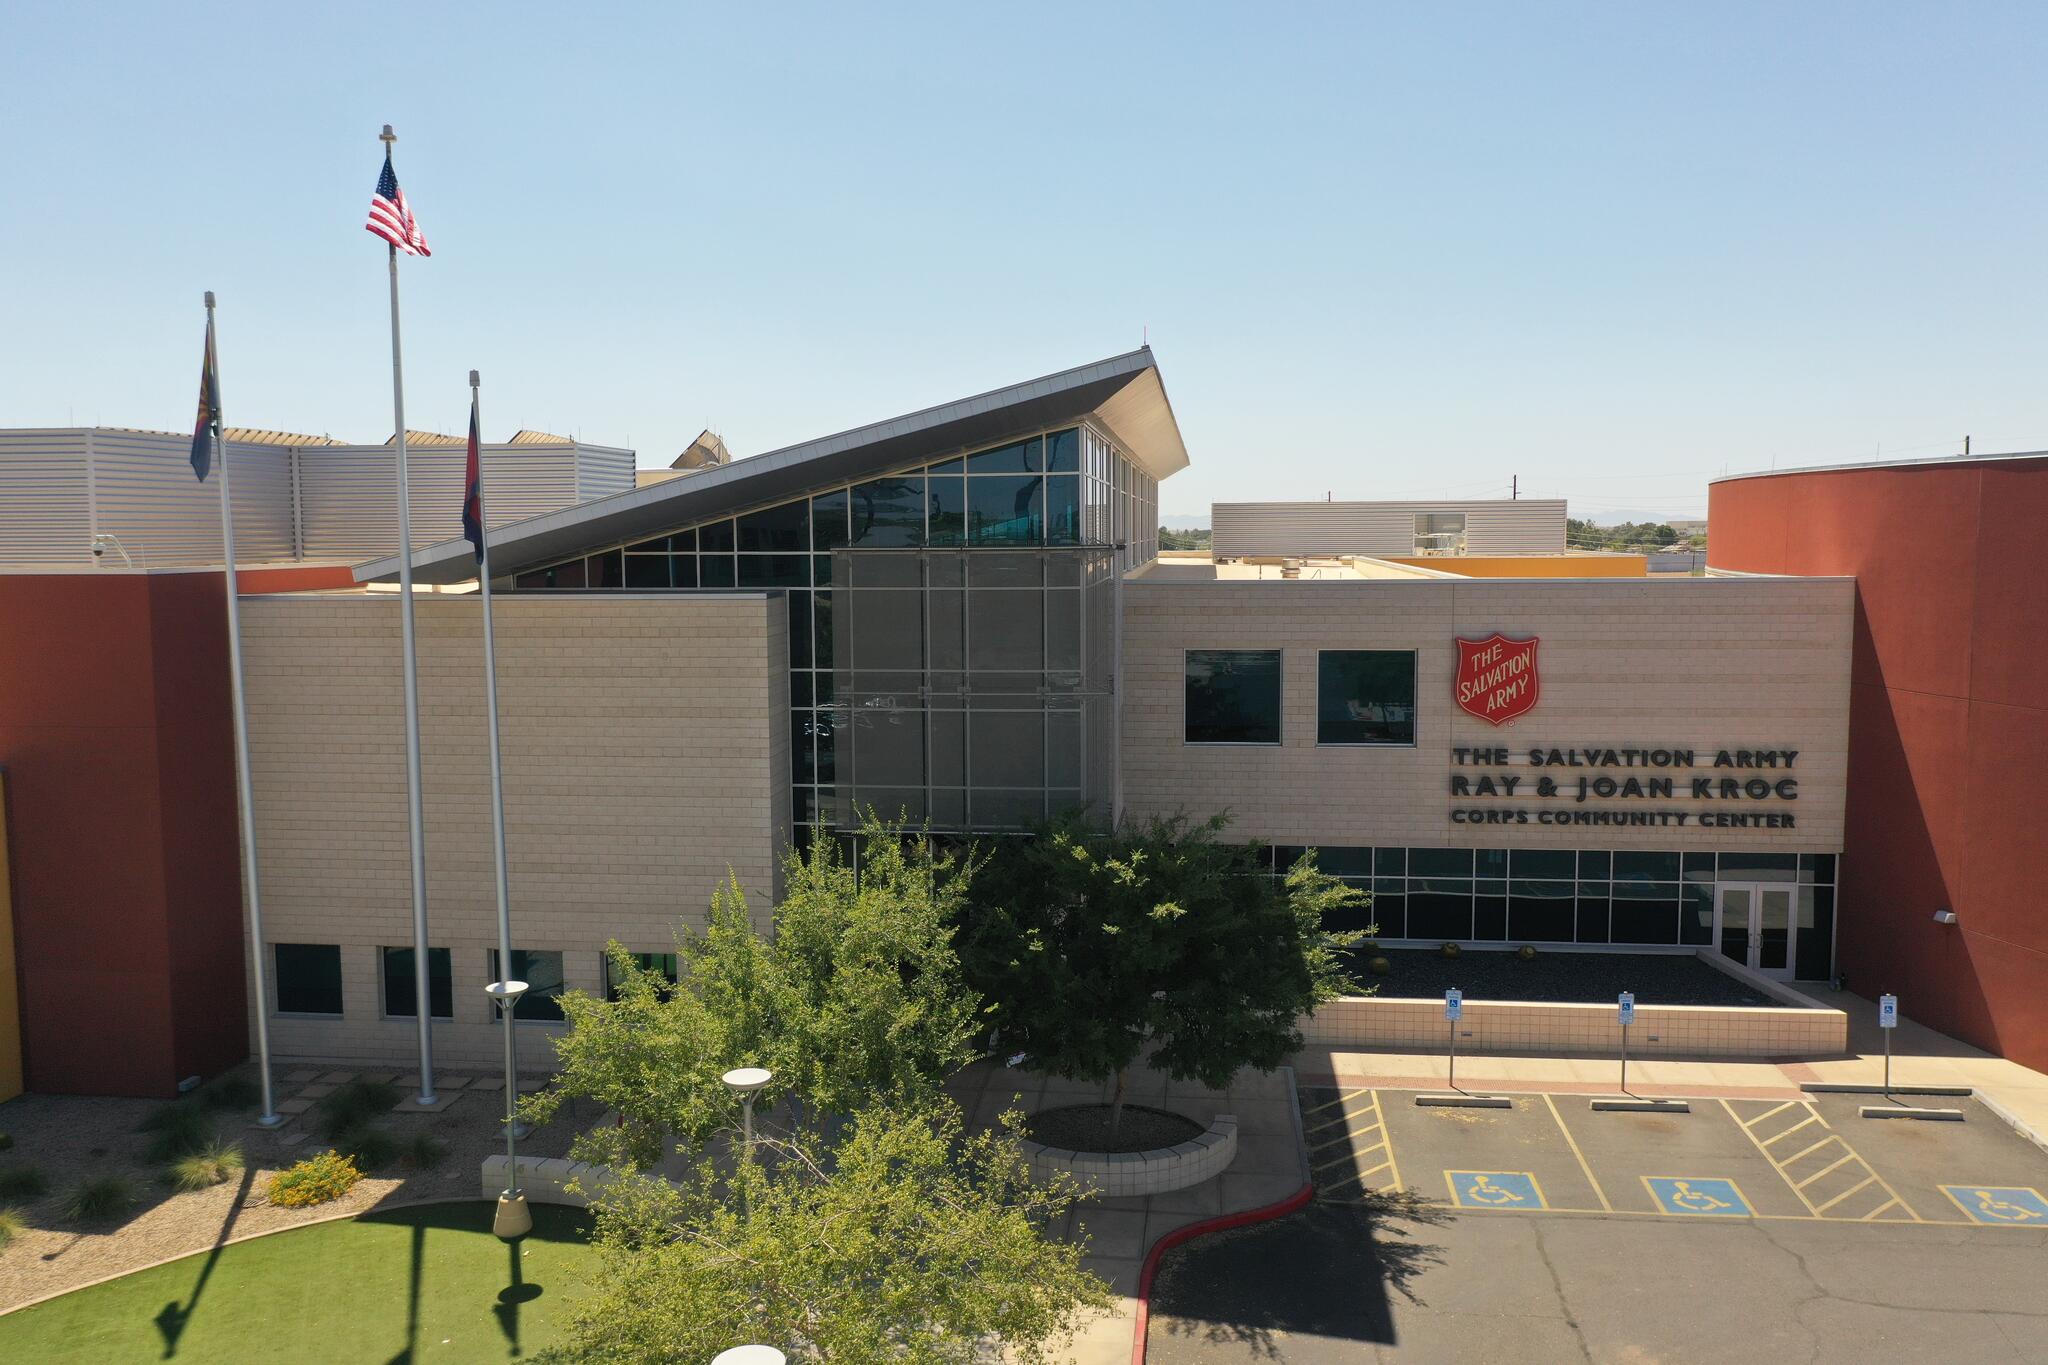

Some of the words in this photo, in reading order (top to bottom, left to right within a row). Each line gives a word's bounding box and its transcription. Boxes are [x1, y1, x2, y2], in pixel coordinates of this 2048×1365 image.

[1472, 643, 1503, 672] THE
[1460, 648, 1530, 703] SALVATION
[1486, 673, 1529, 713] ARMY
[1453, 748, 1508, 766] THE
[1529, 749, 1694, 767] SALVATION
[1714, 750, 1798, 768] ARMY
[1452, 776, 1521, 797] RAY
[1537, 776, 1558, 797] &
[1576, 777, 1672, 802] JOAN
[1692, 778, 1798, 800] KROC
[1451, 809, 1529, 824] CORPS
[1538, 810, 1689, 826] COMMUNITY
[1699, 812, 1795, 828] CENTER
